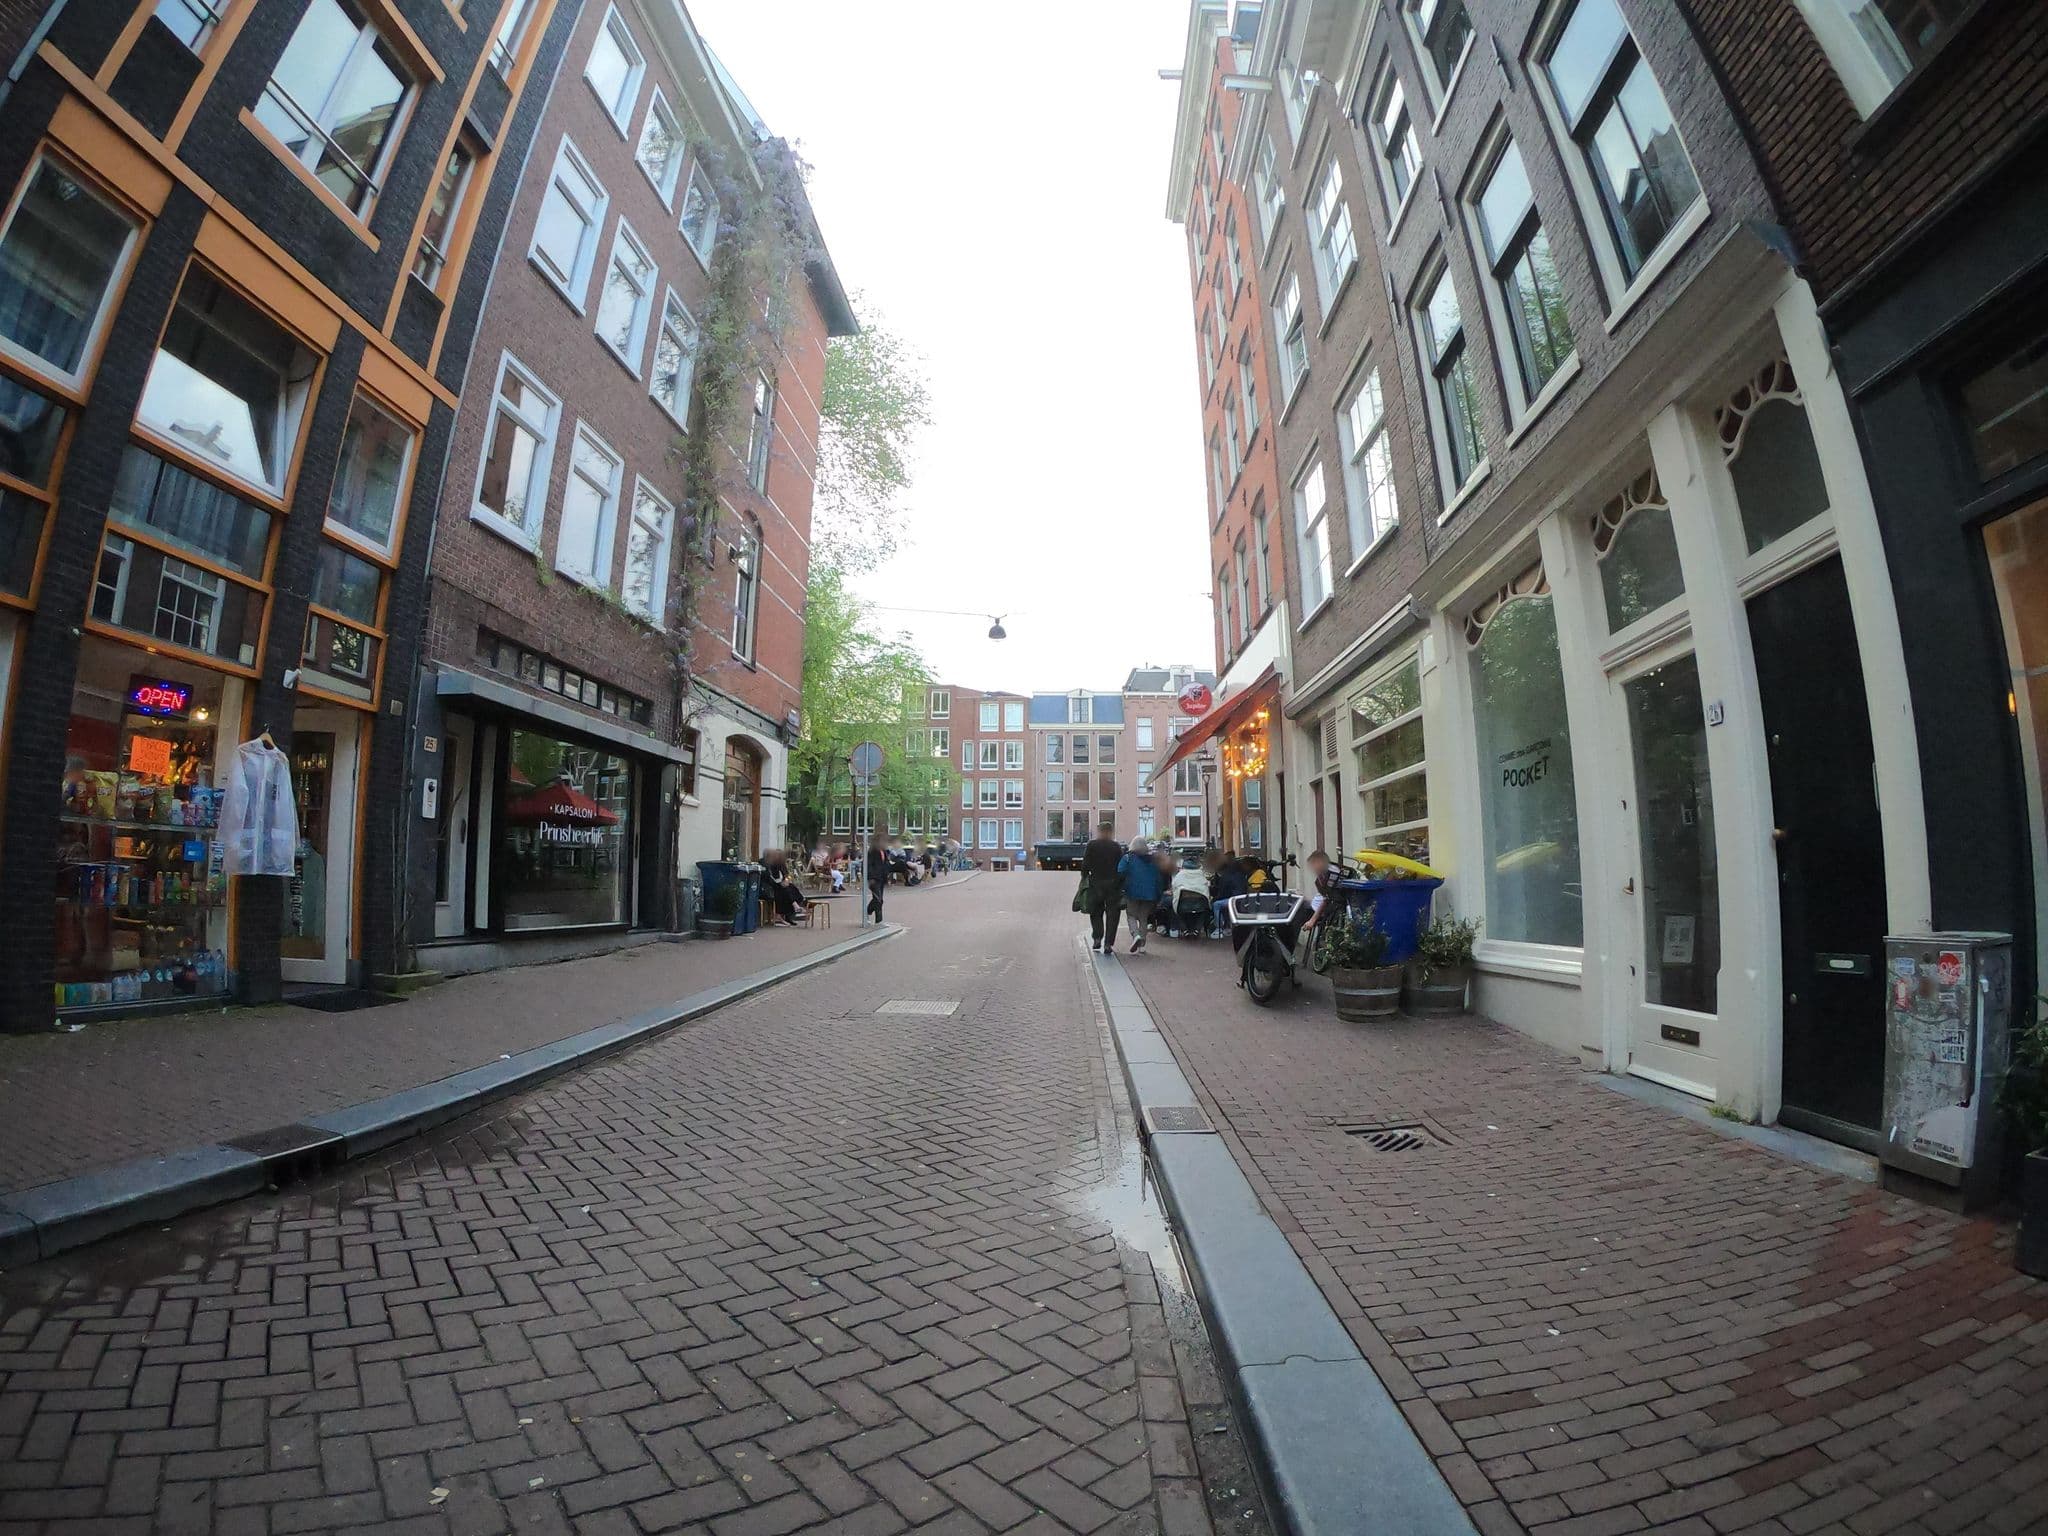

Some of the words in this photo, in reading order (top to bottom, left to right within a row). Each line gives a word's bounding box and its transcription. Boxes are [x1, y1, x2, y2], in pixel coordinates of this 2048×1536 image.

[138, 687, 183, 709] OPEN
[1503, 755, 1550, 787] POCKET
[554, 803, 593, 819] KAPSALON
[540, 821, 605, 848] Prinsheerlijk
